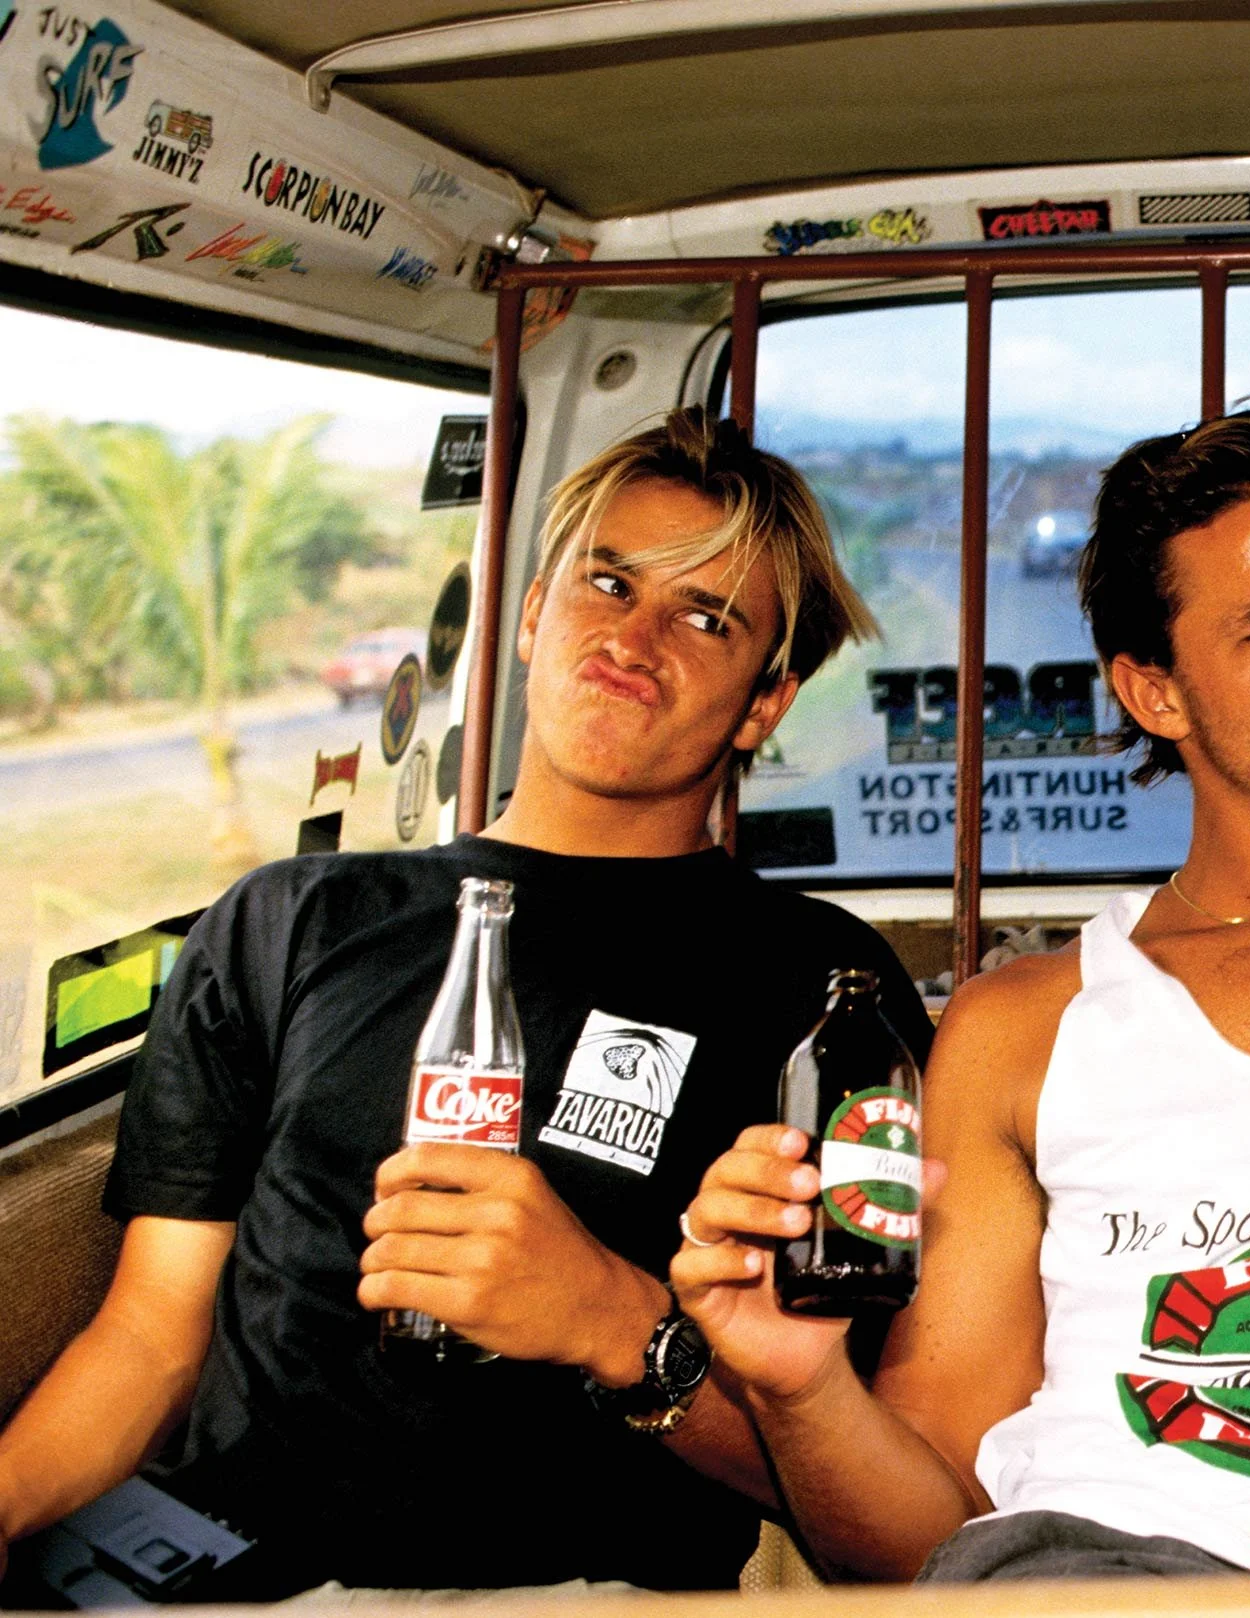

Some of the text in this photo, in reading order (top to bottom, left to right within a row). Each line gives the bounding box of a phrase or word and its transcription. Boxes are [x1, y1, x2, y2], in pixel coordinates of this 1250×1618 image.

[27, 42, 146, 146] SURF
[132, 136, 204, 184] JIMMY'Z
[242, 151, 348, 225] SCORPION
[338, 192, 386, 240] BAY
[424, 1075, 521, 1123] Coke
[548, 1089, 666, 1159] TAVARUA
[1100, 1211, 1167, 1256] The
